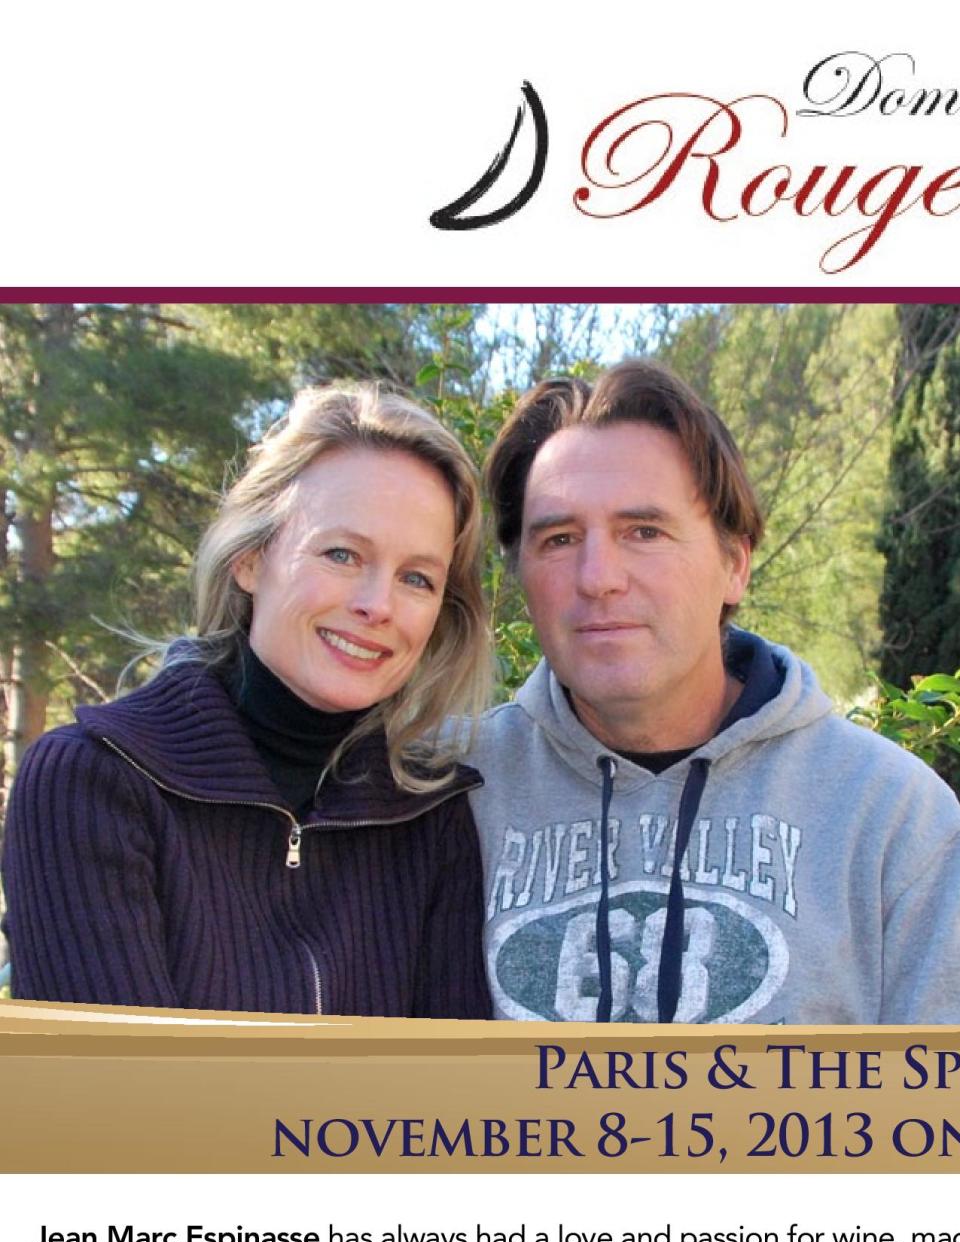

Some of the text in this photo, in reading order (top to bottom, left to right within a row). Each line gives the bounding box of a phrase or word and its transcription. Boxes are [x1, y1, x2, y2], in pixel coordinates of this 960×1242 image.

[486, 813, 801, 921] RIVER VALLEY
[535, 1044, 688, 1090] PARIS
[707, 1044, 756, 1090] &
[766, 1044, 883, 1089] THE
